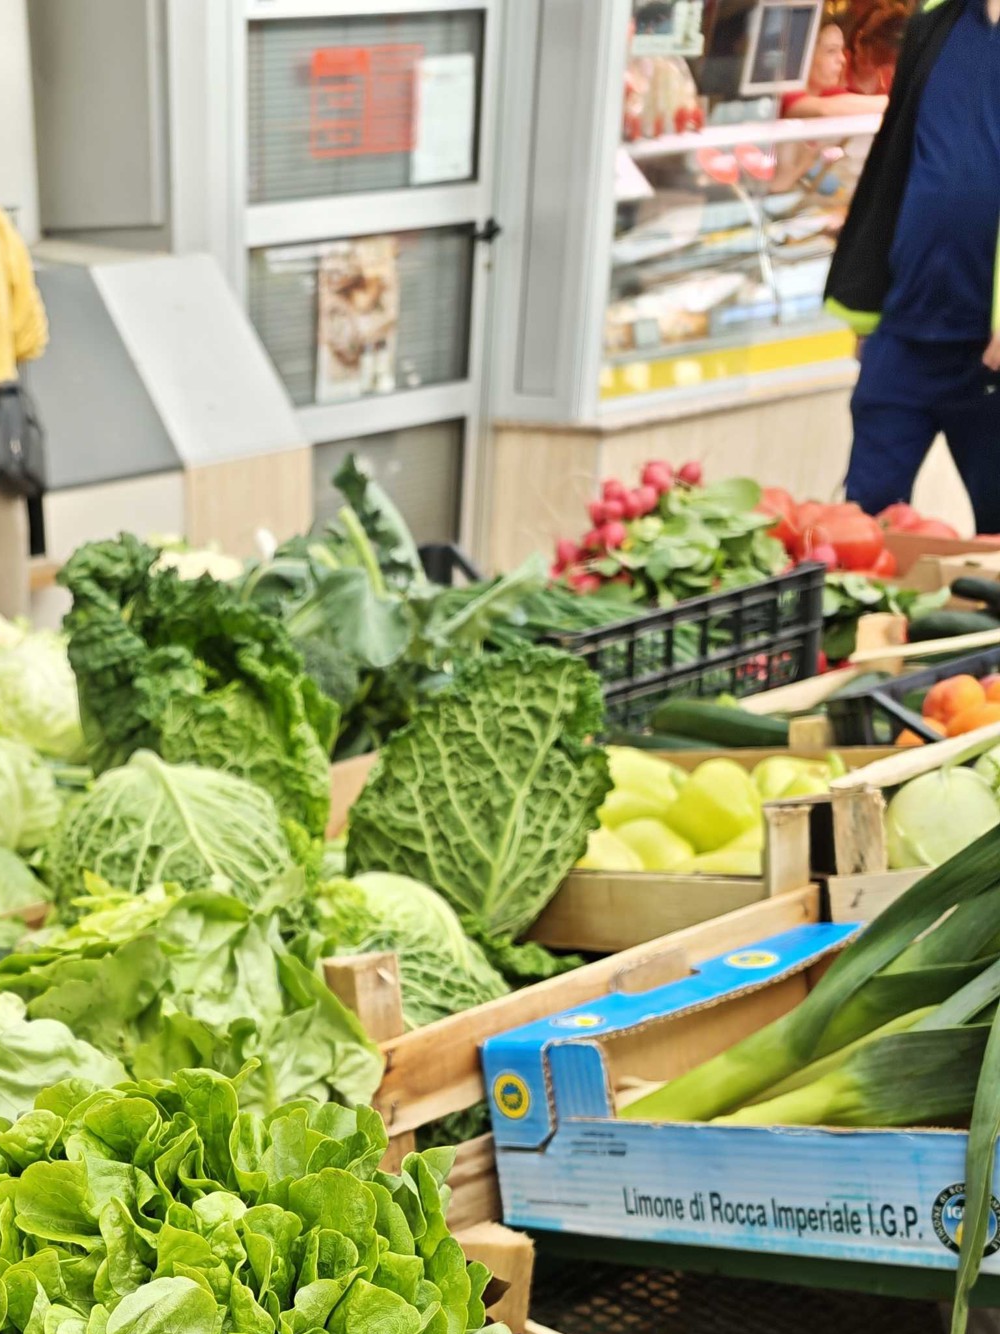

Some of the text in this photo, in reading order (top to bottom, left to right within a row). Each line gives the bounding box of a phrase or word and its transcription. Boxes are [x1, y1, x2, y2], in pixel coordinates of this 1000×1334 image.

[623, 1186, 923, 1240] Limone di Rocca Imperiale I.G.P.
